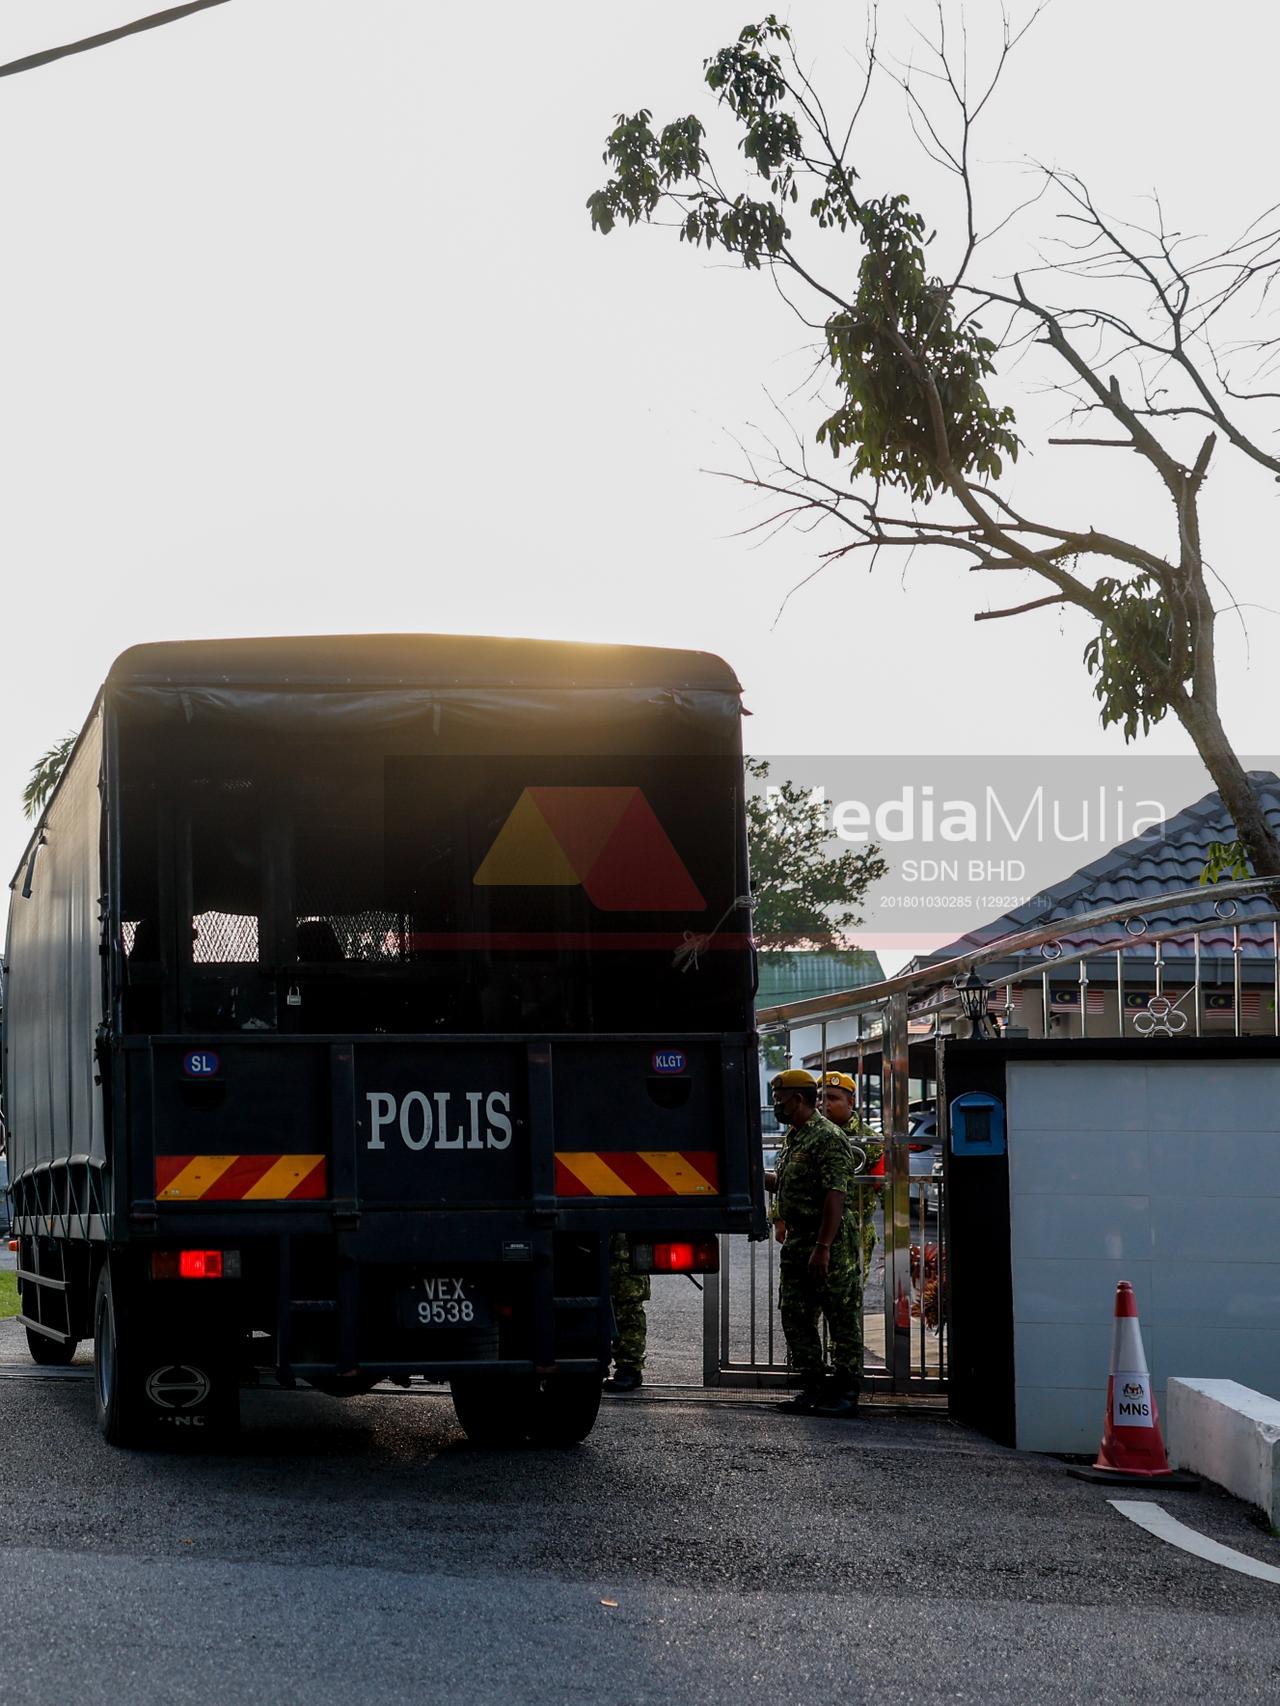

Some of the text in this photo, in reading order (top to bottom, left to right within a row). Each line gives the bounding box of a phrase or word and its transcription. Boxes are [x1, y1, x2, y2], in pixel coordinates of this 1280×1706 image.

[191, 1055, 211, 1072] SL
[655, 1055, 682, 1068] KLGT
[366, 1090, 513, 1151] POLIS
[423, 1278, 466, 1300] VEX
[417, 1300, 474, 1324] 9538
[1119, 1402, 1149, 1416] MNS
